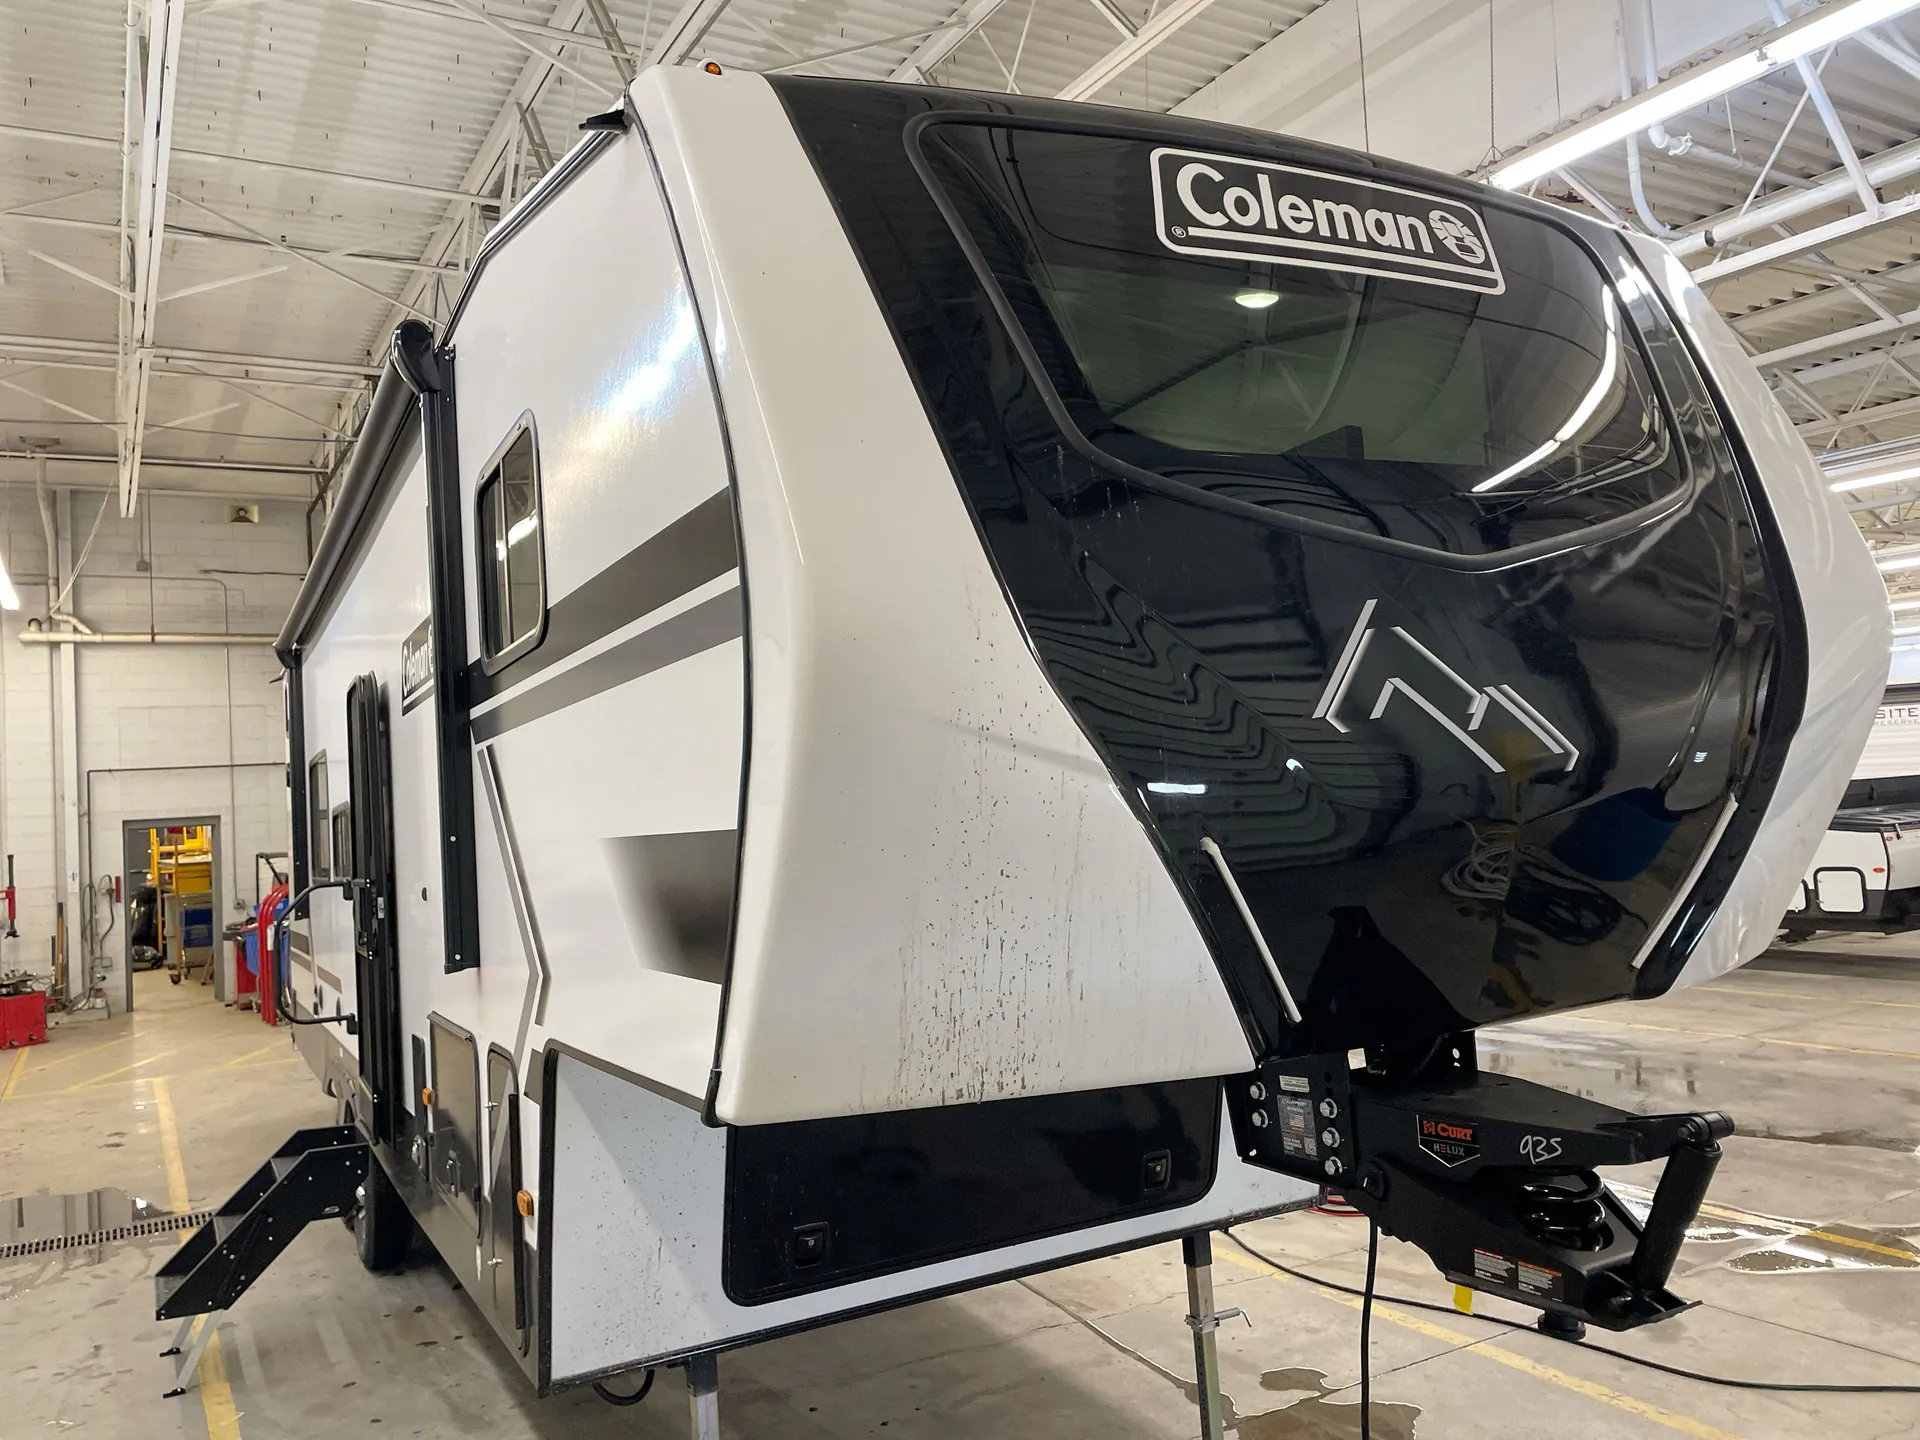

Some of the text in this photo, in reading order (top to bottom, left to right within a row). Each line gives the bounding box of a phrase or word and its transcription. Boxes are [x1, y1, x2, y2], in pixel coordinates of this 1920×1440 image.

[1176, 162, 1435, 254] Coleman
[402, 640, 429, 697] Coleman
[1433, 1142, 1465, 1157] HELUX
[1519, 1135, 1563, 1165] 935
